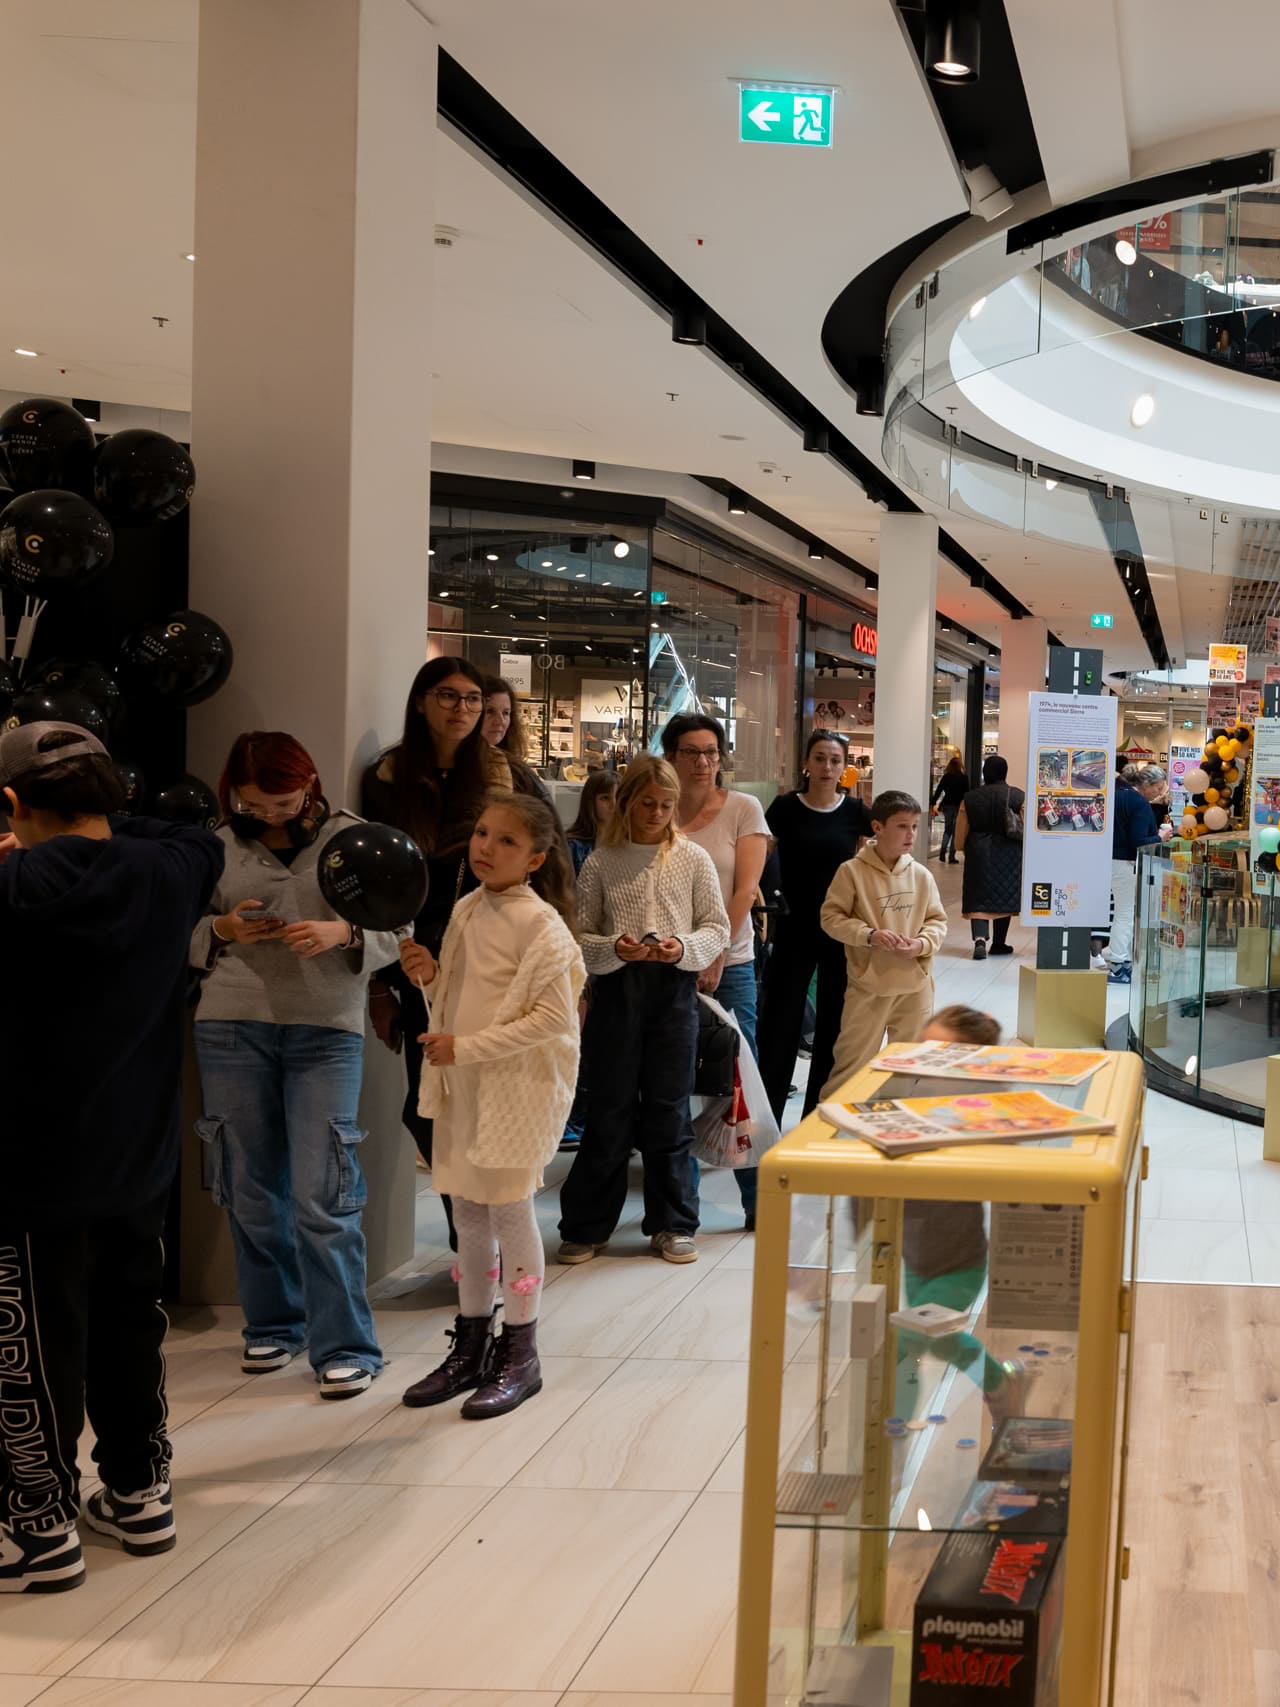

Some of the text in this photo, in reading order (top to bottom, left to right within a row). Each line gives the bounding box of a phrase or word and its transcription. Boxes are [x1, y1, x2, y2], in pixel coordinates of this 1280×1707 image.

[140, 1488, 162, 1500] FILA
[922, 1615, 1025, 1640] playmobil
[918, 1642, 1025, 1688] Astérix
